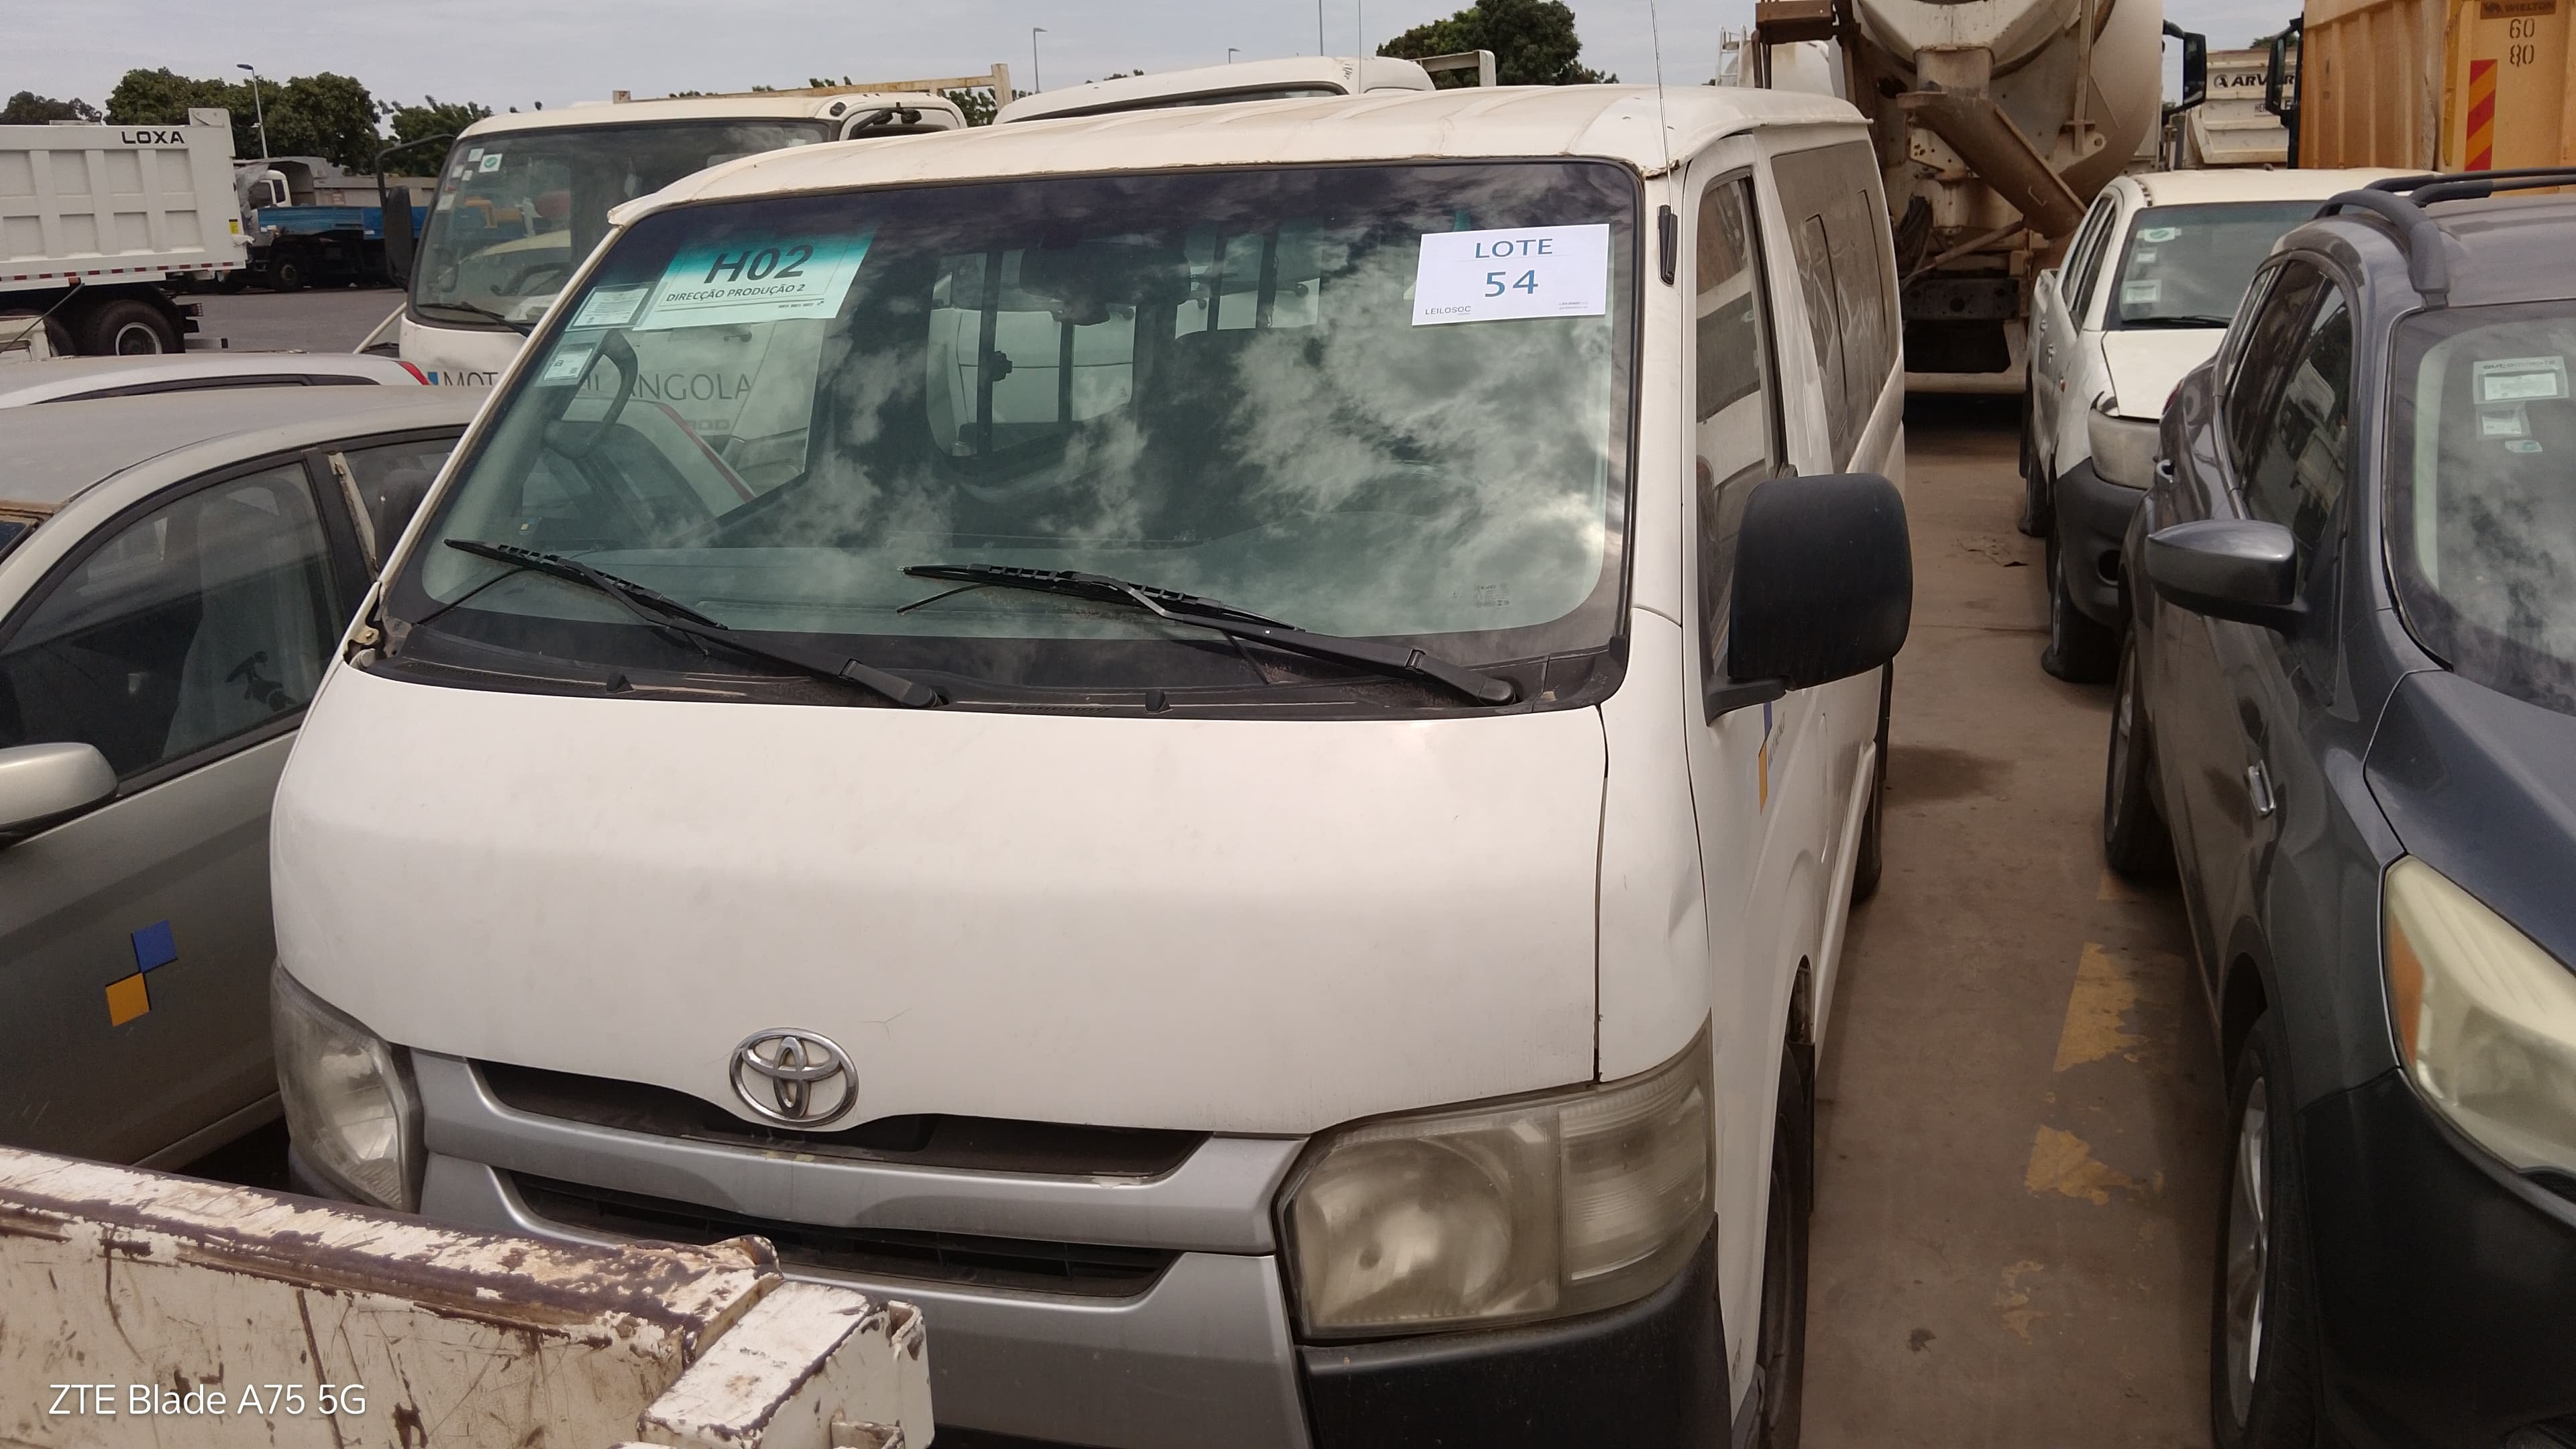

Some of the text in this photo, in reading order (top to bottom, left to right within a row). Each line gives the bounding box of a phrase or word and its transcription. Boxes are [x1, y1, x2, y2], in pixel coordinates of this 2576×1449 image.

[2510, 18, 2534, 38] 60
[2510, 44, 2534, 65] 80
[121, 131, 186, 144] LOXA
[1475, 238, 1554, 258] LOTE
[703, 244, 814, 284] H02
[666, 284, 806, 302] DIRECÇÃO PRODUÇÃO 2
[1485, 269, 1539, 297] 54
[1425, 305, 1471, 315] LEILOSOC
[631, 372, 751, 401] NGOLA
